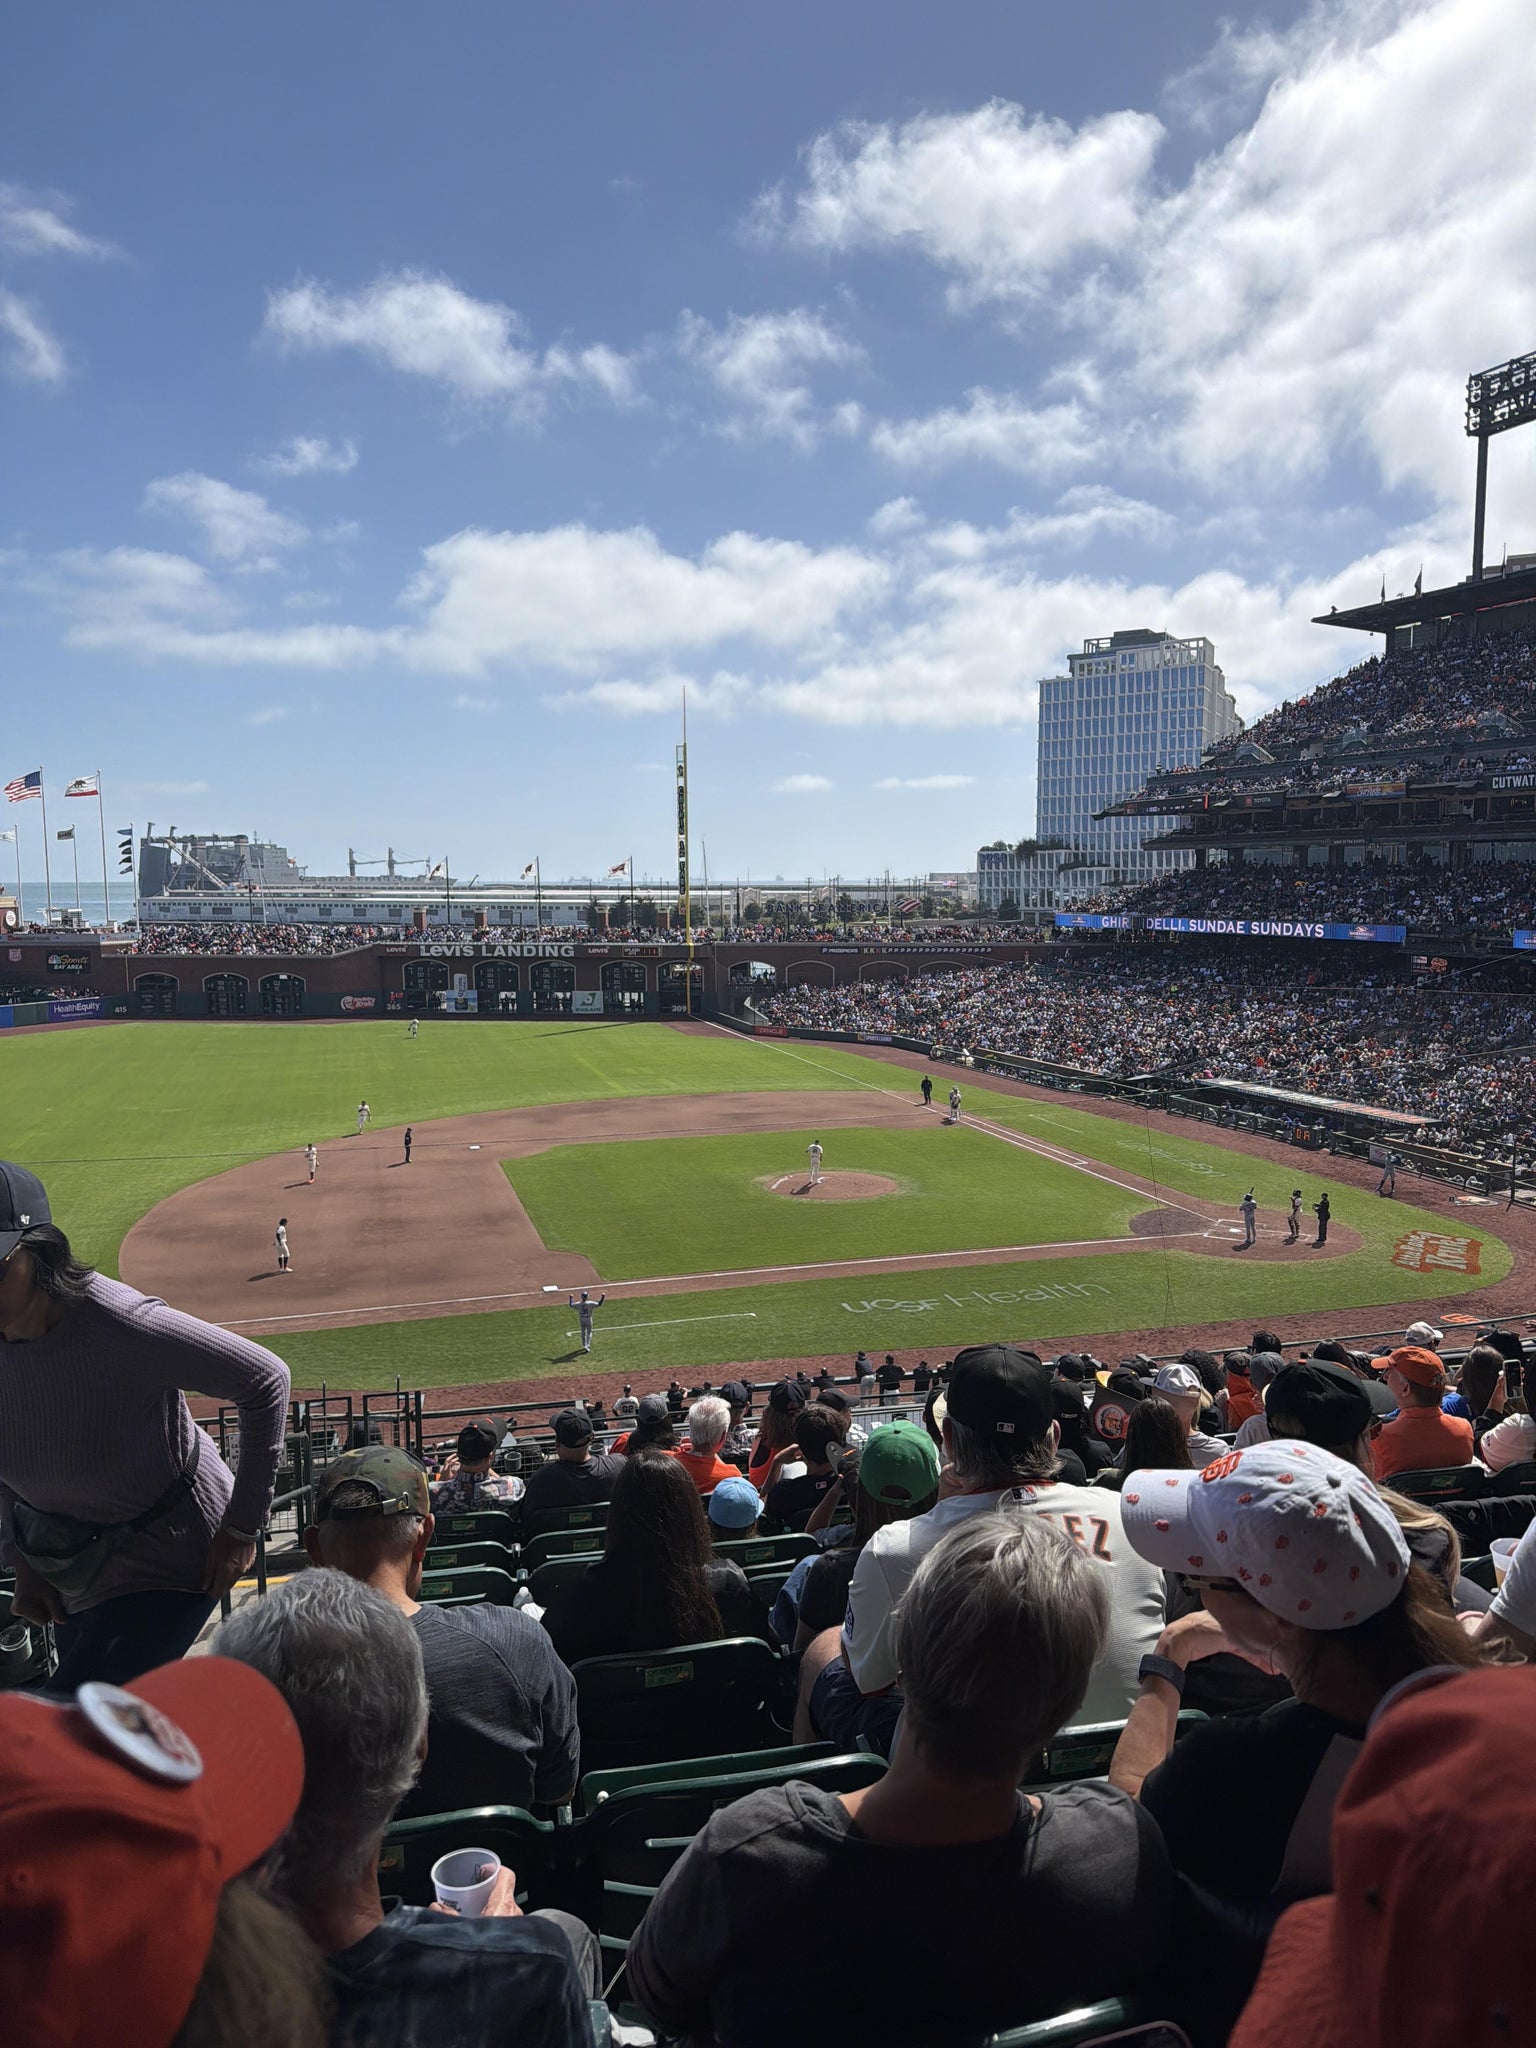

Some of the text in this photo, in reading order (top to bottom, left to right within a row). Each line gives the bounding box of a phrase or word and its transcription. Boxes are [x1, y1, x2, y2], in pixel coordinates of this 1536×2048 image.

[1492, 774, 1536, 789] CUTWAT
[767, 903, 889, 913] BANK OF AMERICA
[1189, 919, 1245, 934] SUNDAE
[1250, 921, 1325, 938] SUNDAYS
[481, 945, 575, 957] LANDING
[59, 954, 89, 965] Sports
[53, 1002, 100, 1014] HealthEquity
[114, 1006, 127, 1014] 415
[841, 1282, 1111, 1313] UCSF Health
